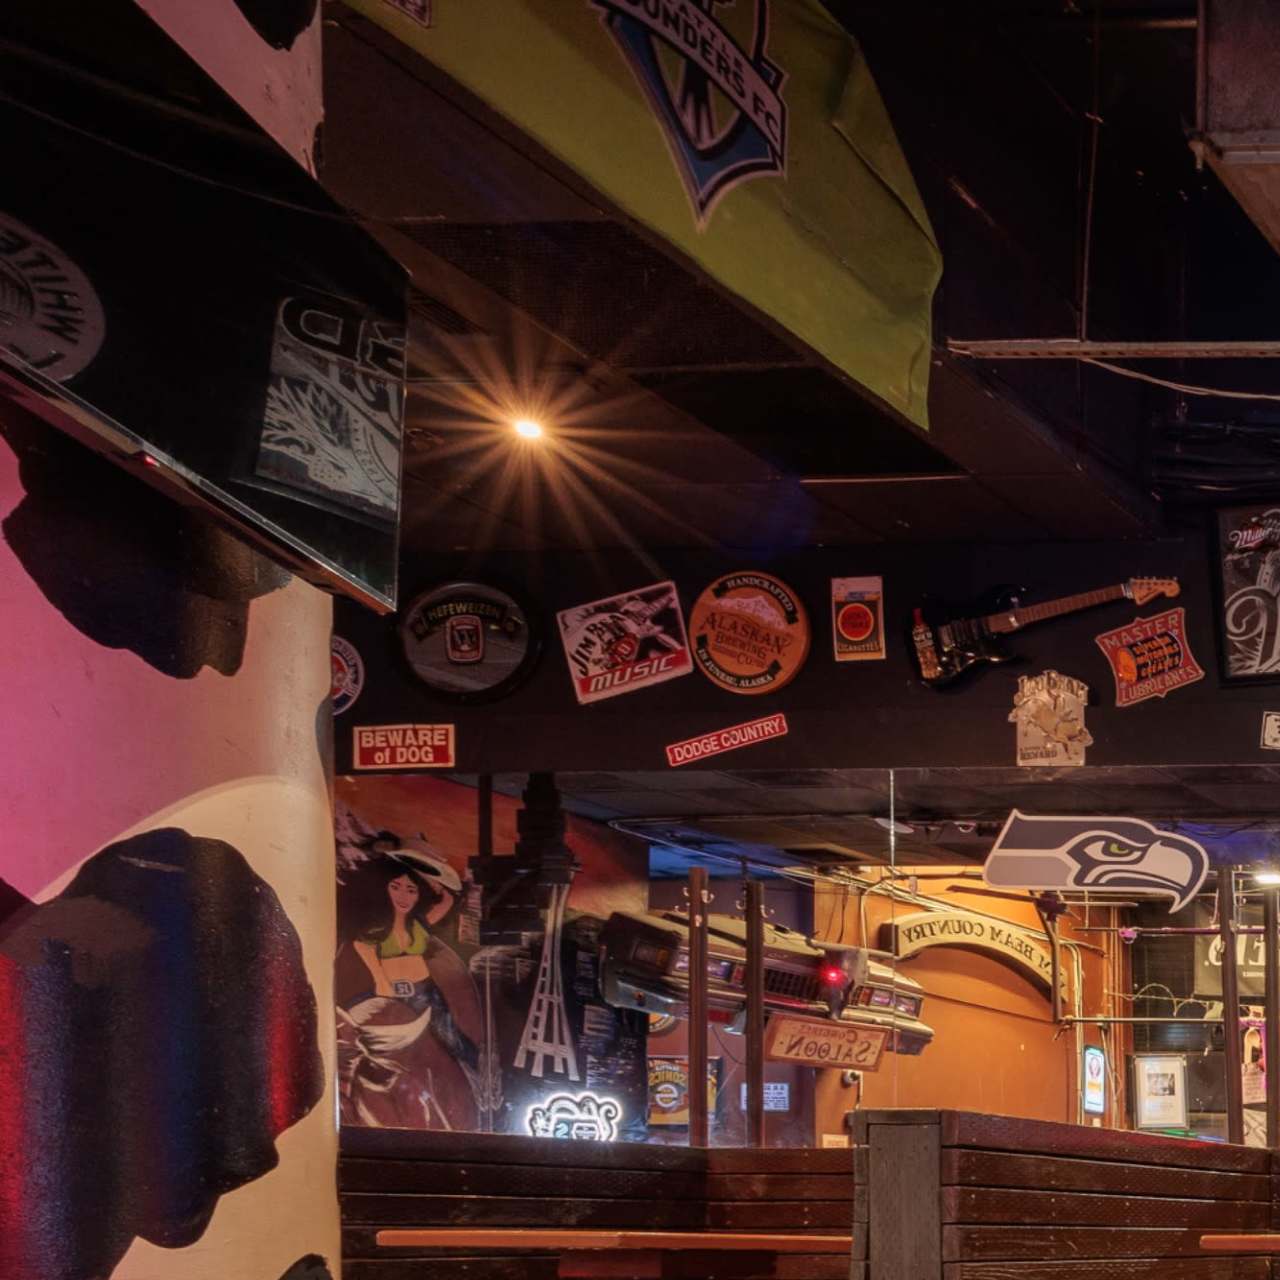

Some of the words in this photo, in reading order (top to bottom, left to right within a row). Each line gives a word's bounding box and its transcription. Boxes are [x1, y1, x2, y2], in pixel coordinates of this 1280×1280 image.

[752, 92, 789, 143] FC
[1102, 615, 1181, 650] MASTER
[589, 653, 678, 693] MUSIC
[1121, 665, 1196, 701] LUBRICANTS
[360, 728, 448, 748] BEWARE
[373, 749, 392, 764] of
[396, 746, 435, 763] DOG
[673, 737, 720, 762] DODGE
[720, 717, 784, 748] COUNTRY
